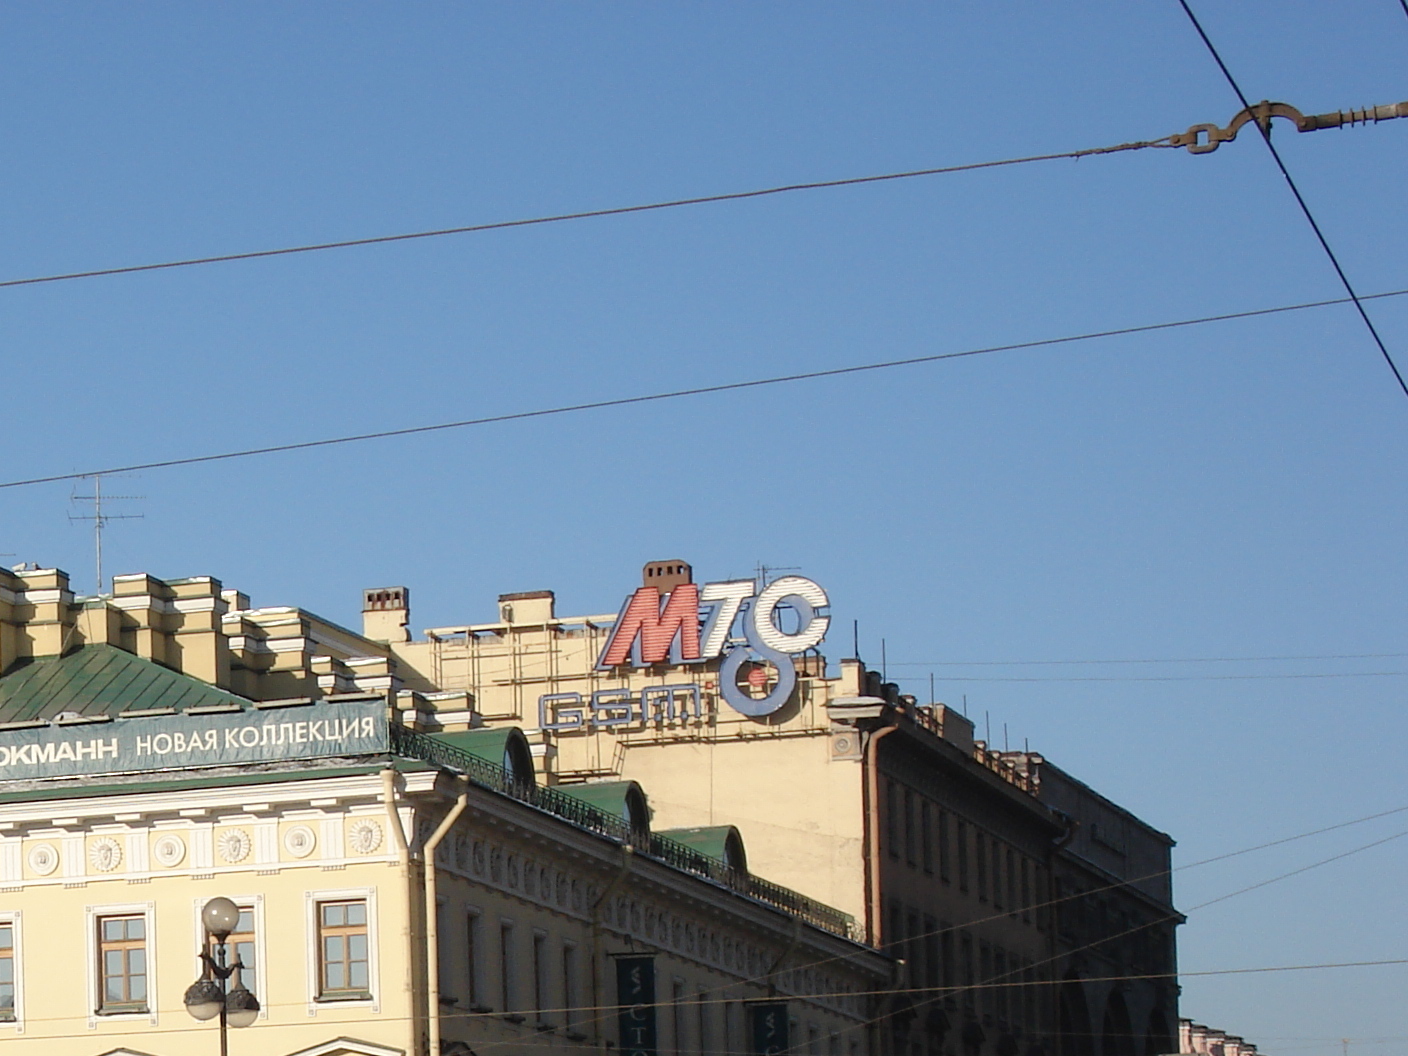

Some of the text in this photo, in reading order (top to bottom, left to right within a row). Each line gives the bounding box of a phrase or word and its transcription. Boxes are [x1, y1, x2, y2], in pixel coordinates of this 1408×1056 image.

[598, 575, 831, 666] МТС
[137, 730, 217, 755] НОВАЯ
[225, 717, 374, 749] КОЛЛЕКЦИЯ
